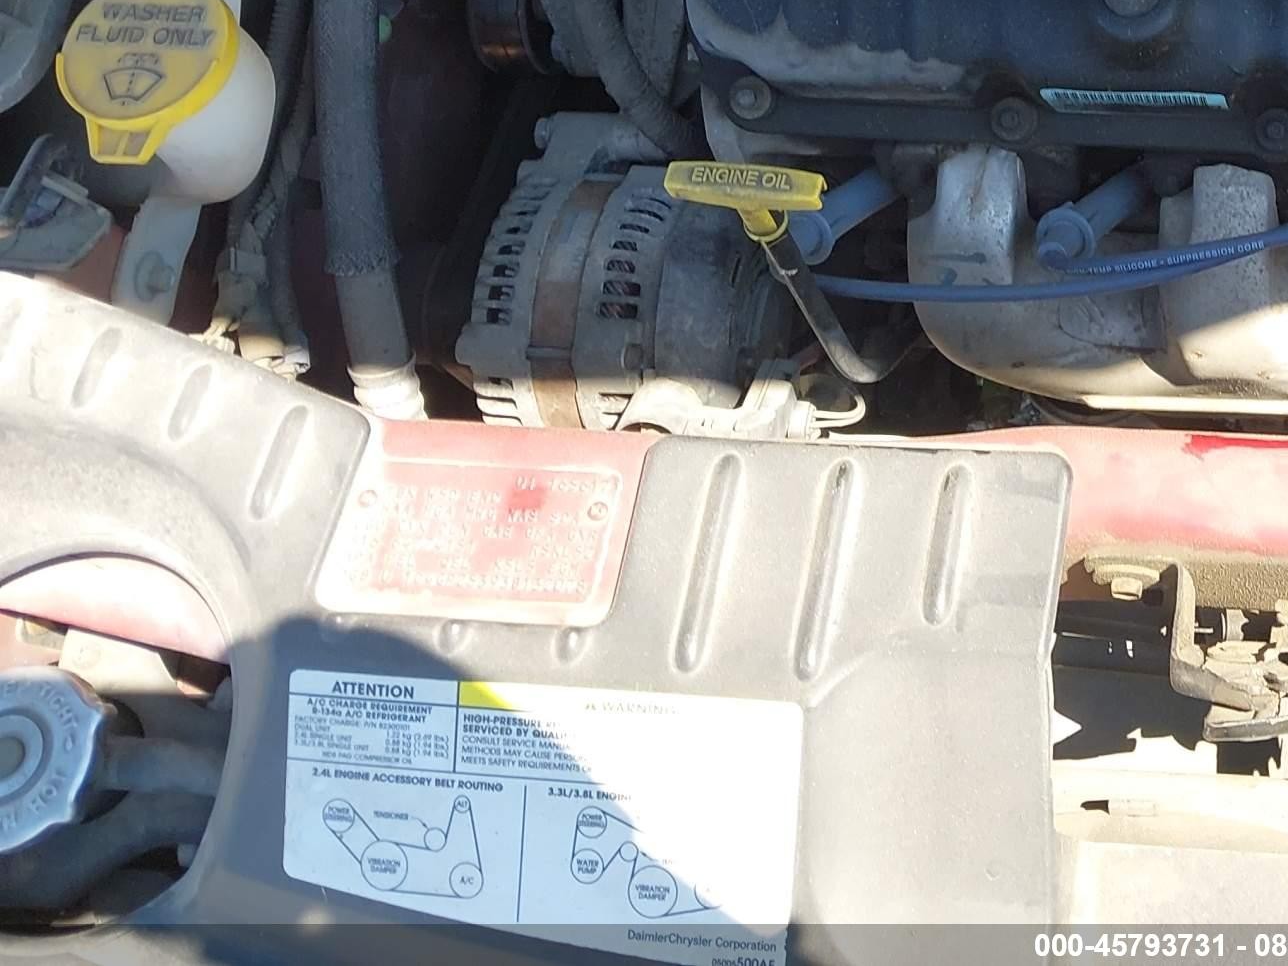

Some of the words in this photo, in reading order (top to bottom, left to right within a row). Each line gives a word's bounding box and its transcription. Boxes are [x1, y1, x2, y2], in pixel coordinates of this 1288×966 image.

[102, 2, 207, 23] WASHER
[75, 23, 145, 43] FLUID
[153, 27, 216, 48] ONLY
[691, 167, 758, 185] ENGINE
[761, 173, 791, 191] OIL
[1167, 246, 1236, 267] SUPPRESSION
[1237, 239, 1266, 253] CORE
[332, 681, 415, 700] ATTENTION
[307, 698, 326, 707] A/C
[329, 699, 368, 711] CHARGE
[370, 702, 433, 715] REQUIREMENT
[345, 709, 363, 719] A/C
[366, 710, 427, 723] REFRIGERANT
[463, 713, 541, 728] HIGH-PRESSURE
[463, 724, 513, 736] SERVICED
[516, 727, 529, 737] BY
[462, 735, 501, 745] CONSULT
[502, 737, 536, 748] SERVICE
[462, 745, 501, 755] METHODS
[503, 747, 521, 756] MAY
[524, 750, 551, 760] CAUSE
[461, 755, 487, 765] MEETS
[488, 757, 517, 768] SAFETY
[518, 761, 580, 772] REQUIREMENTS
[311, 767, 333, 778] 2.4L
[334, 770, 370, 781] ENGINE
[371, 772, 432, 787] ACCESSORY
[434, 777, 455, 788] BELT
[457, 779, 504, 792] ROUTING
[547, 787, 594, 800] 3.3L/3.8L
[456, 800, 469, 808] ALT
[576, 859, 599, 867] WATER
[578, 867, 597, 875] PUMP
[459, 876, 474, 885] A/C
[635, 884, 670, 894] VIBRATION
[627, 929, 712, 947] DaimlerChrysler
[715, 936, 777, 953] Corporation
